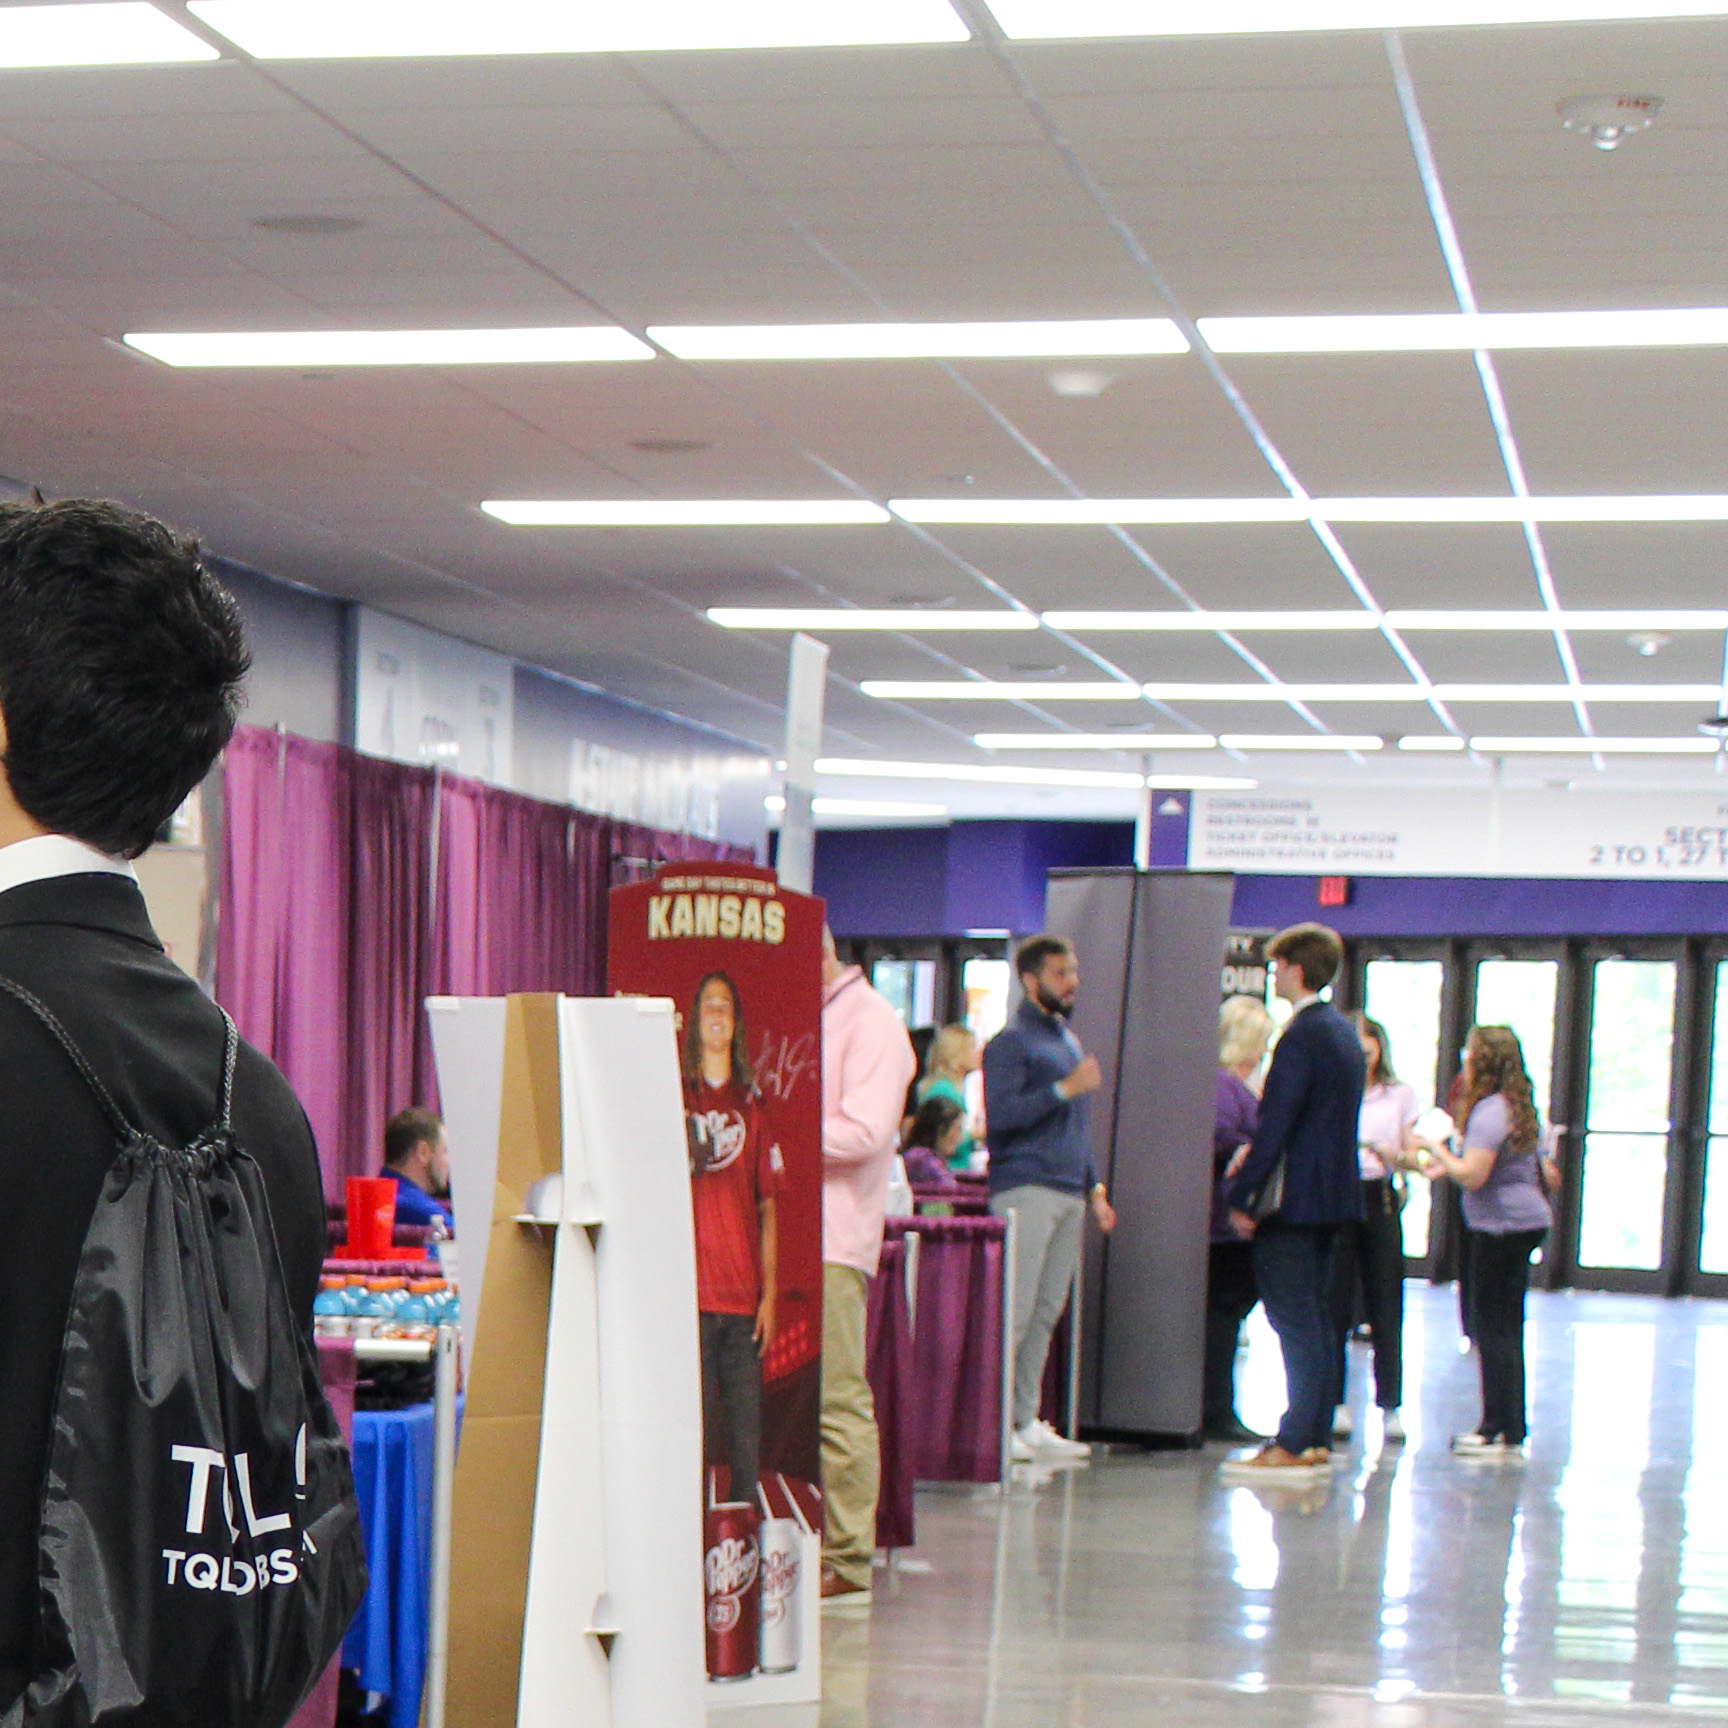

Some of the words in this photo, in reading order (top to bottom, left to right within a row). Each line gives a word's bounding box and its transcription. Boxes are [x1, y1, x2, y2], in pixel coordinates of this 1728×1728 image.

[1664, 826, 1728, 845] SECT
[1614, 845, 1646, 864] TO
[648, 893, 786, 944] KANSAS
